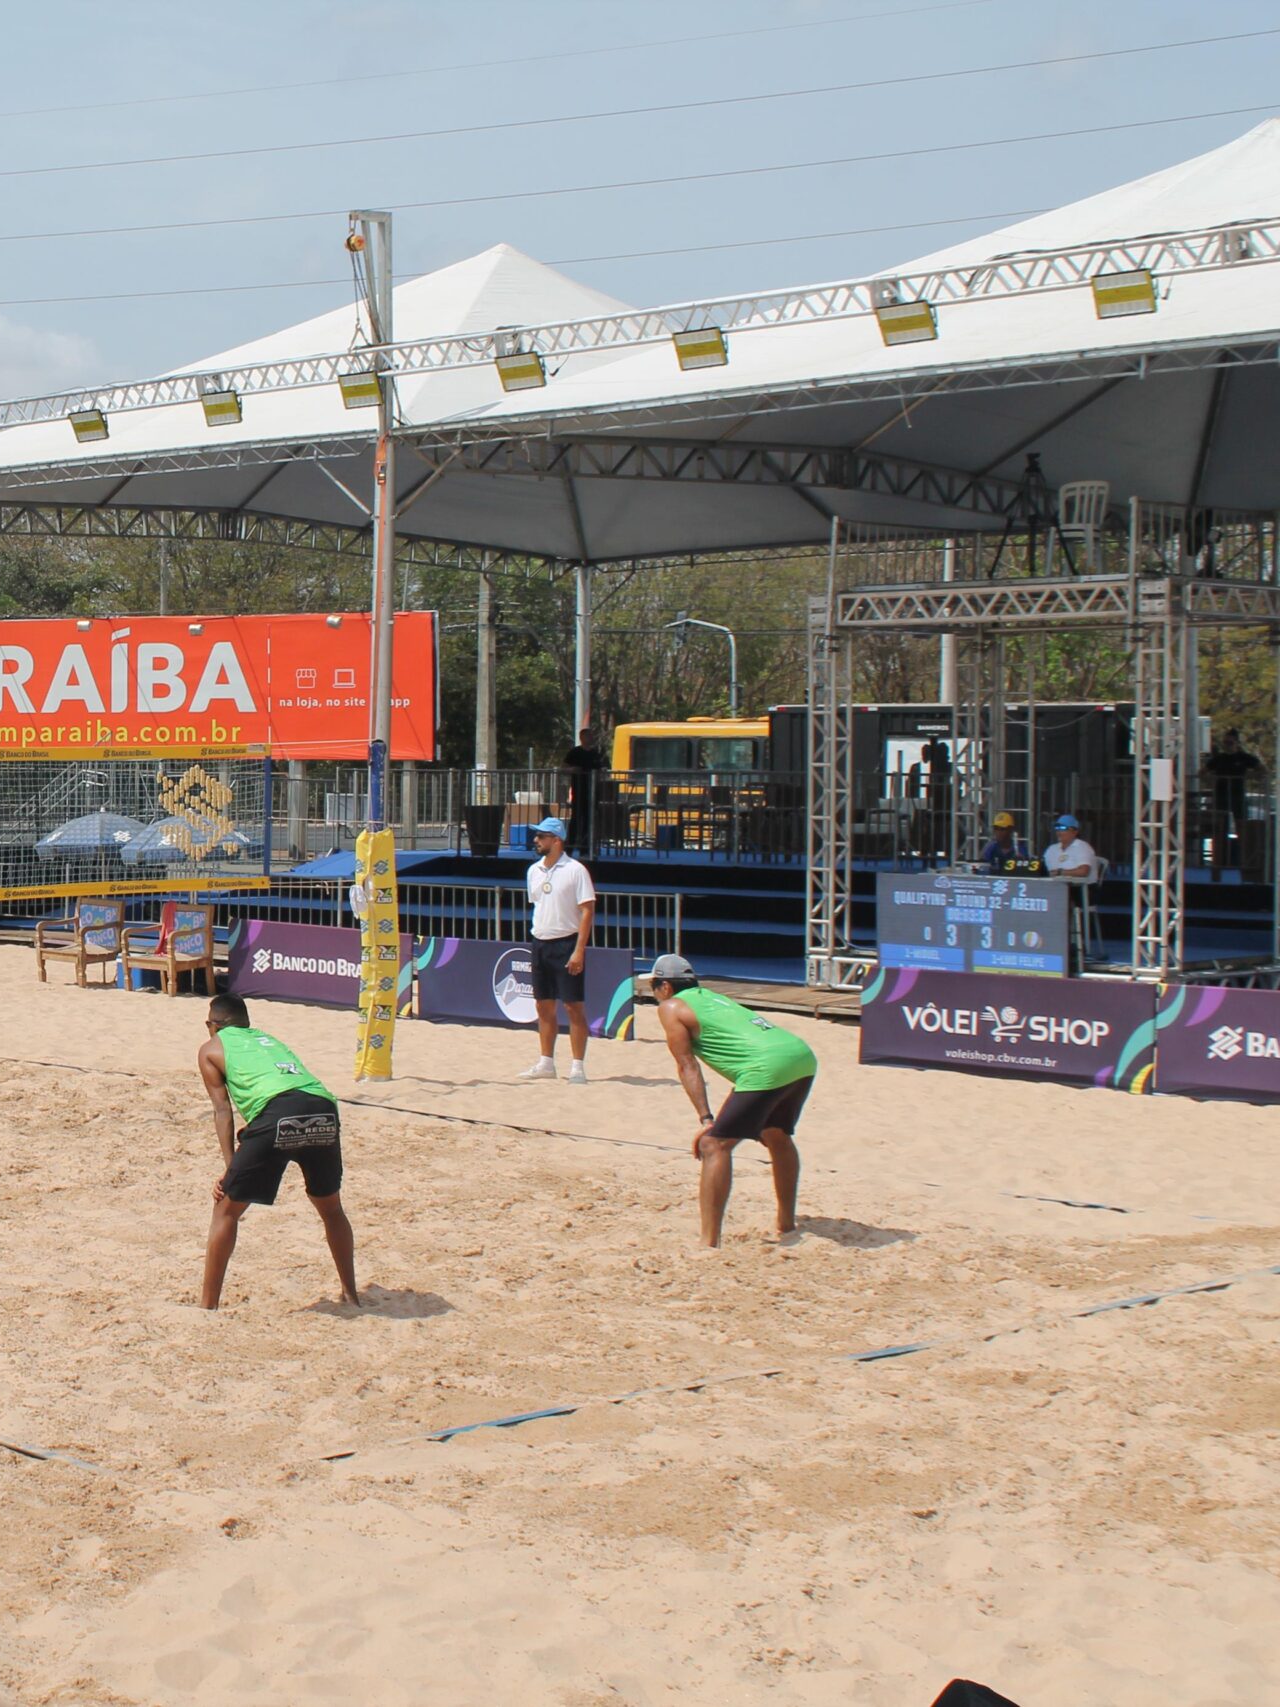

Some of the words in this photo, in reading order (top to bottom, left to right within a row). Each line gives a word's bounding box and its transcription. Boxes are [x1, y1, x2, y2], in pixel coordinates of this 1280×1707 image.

[297, 697, 322, 708] loja,
[344, 697, 366, 706] site
[1004, 860, 1016, 871] 3
[1028, 861, 1040, 871] 3
[1018, 883, 1027, 897] 2
[894, 891, 947, 905] QUALIFYING
[955, 894, 986, 908] ROUND
[988, 896, 1001, 909] 32
[1011, 897, 1048, 911] ABERTO
[923, 926, 931, 940] 0
[946, 924, 957, 946] 3
[981, 926, 992, 948] 3
[1008, 932, 1015, 946] 0
[273, 953, 317, 973] BANCO
[318, 959, 336, 976] DO
[337, 958, 361, 978] BRA
[902, 1002, 977, 1036] VÔLEI
[1028, 1016, 1110, 1047] SHOP
[1246, 1032, 1280, 1058] BA
[945, 1049, 1057, 1068] voleishop.cbv.com.br
